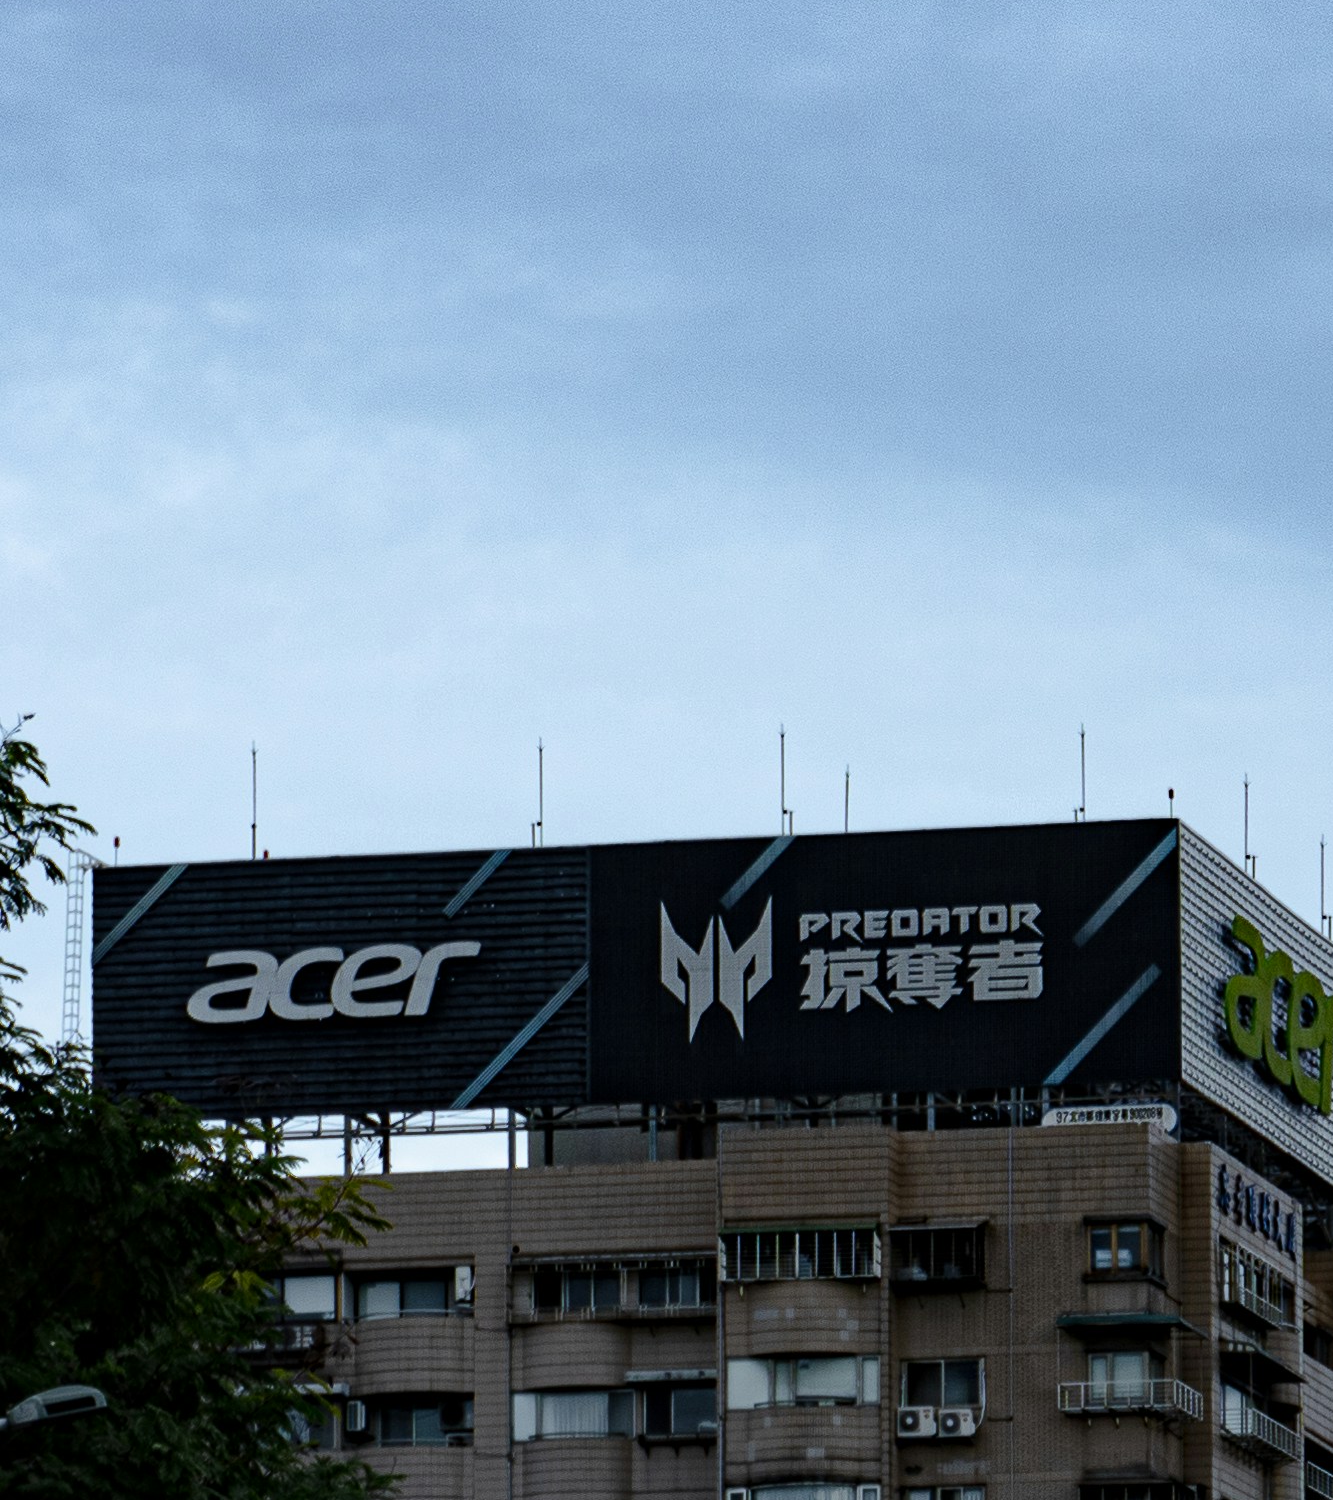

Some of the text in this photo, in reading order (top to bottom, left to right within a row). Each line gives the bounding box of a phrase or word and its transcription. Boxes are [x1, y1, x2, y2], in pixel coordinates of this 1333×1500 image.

[799, 902, 1044, 943] PREDATOR
[186, 941, 481, 1024] acer
[799, 938, 1044, 1013] 掠奪者
